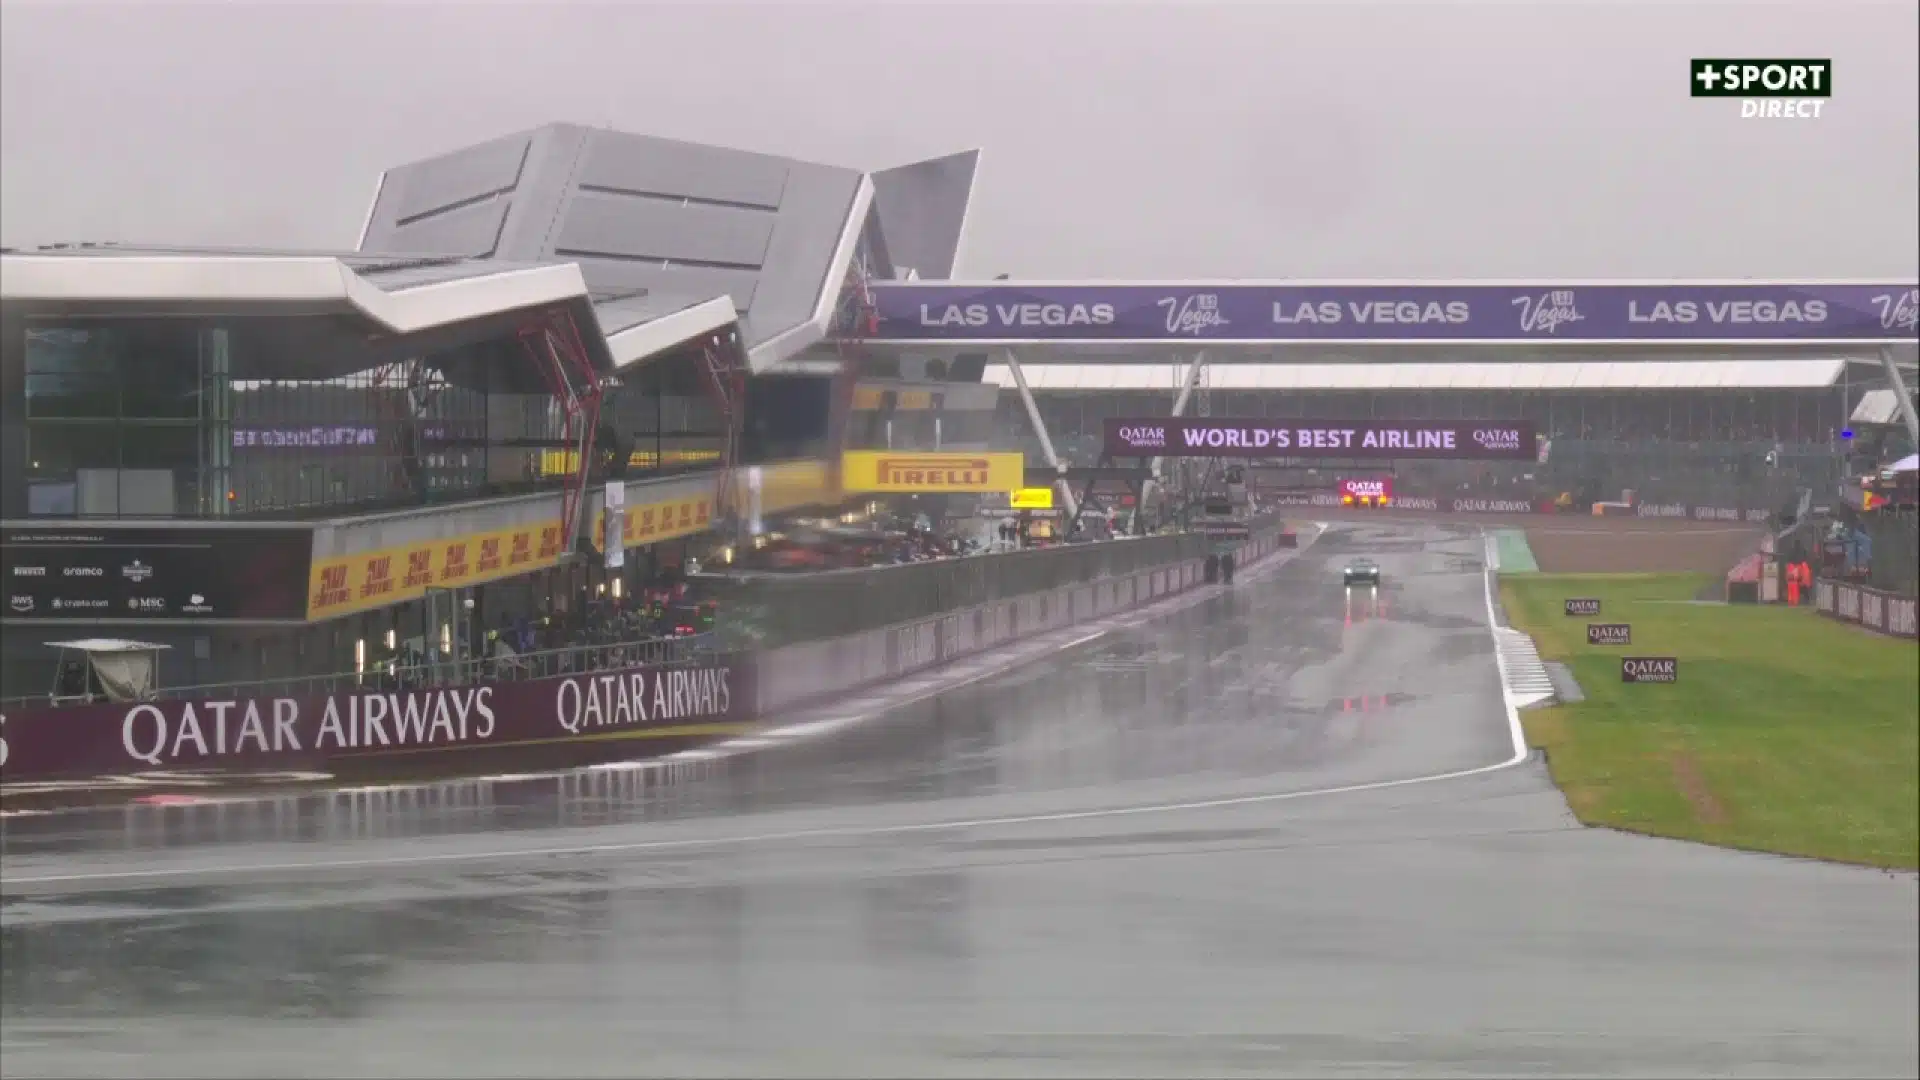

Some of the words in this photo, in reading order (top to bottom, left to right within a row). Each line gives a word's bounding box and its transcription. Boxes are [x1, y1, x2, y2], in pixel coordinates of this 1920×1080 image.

[920, 304, 989, 325] LAS
[996, 303, 1115, 325] VEGAS
[1158, 296, 1229, 334] Vegas
[1272, 302, 1342, 324] LAS
[1349, 302, 1470, 324] VEGAS
[1512, 294, 1584, 333] Vegas
[1628, 300, 1698, 323] LAS
[1705, 300, 1828, 323] VEGAS
[1119, 427, 1165, 441] QATAR
[1183, 428, 1290, 448] WORLD'S
[1298, 429, 1355, 448] BEST
[1362, 429, 1456, 448] AIRLINE
[1473, 429, 1519, 443] QATAR
[877, 459, 989, 485] PIRELLI
[1346, 482, 1383, 492] QATAR
[63, 568, 103, 576] aramco
[1566, 601, 1598, 610] QATAR
[1589, 627, 1628, 638] QATAR
[1624, 661, 1674, 675] QATAR
[557, 673, 646, 733] QATAR
[652, 667, 730, 720] AIRWAYS
[122, 699, 302, 765] QATAR
[315, 686, 496, 749] AIRWAYS
